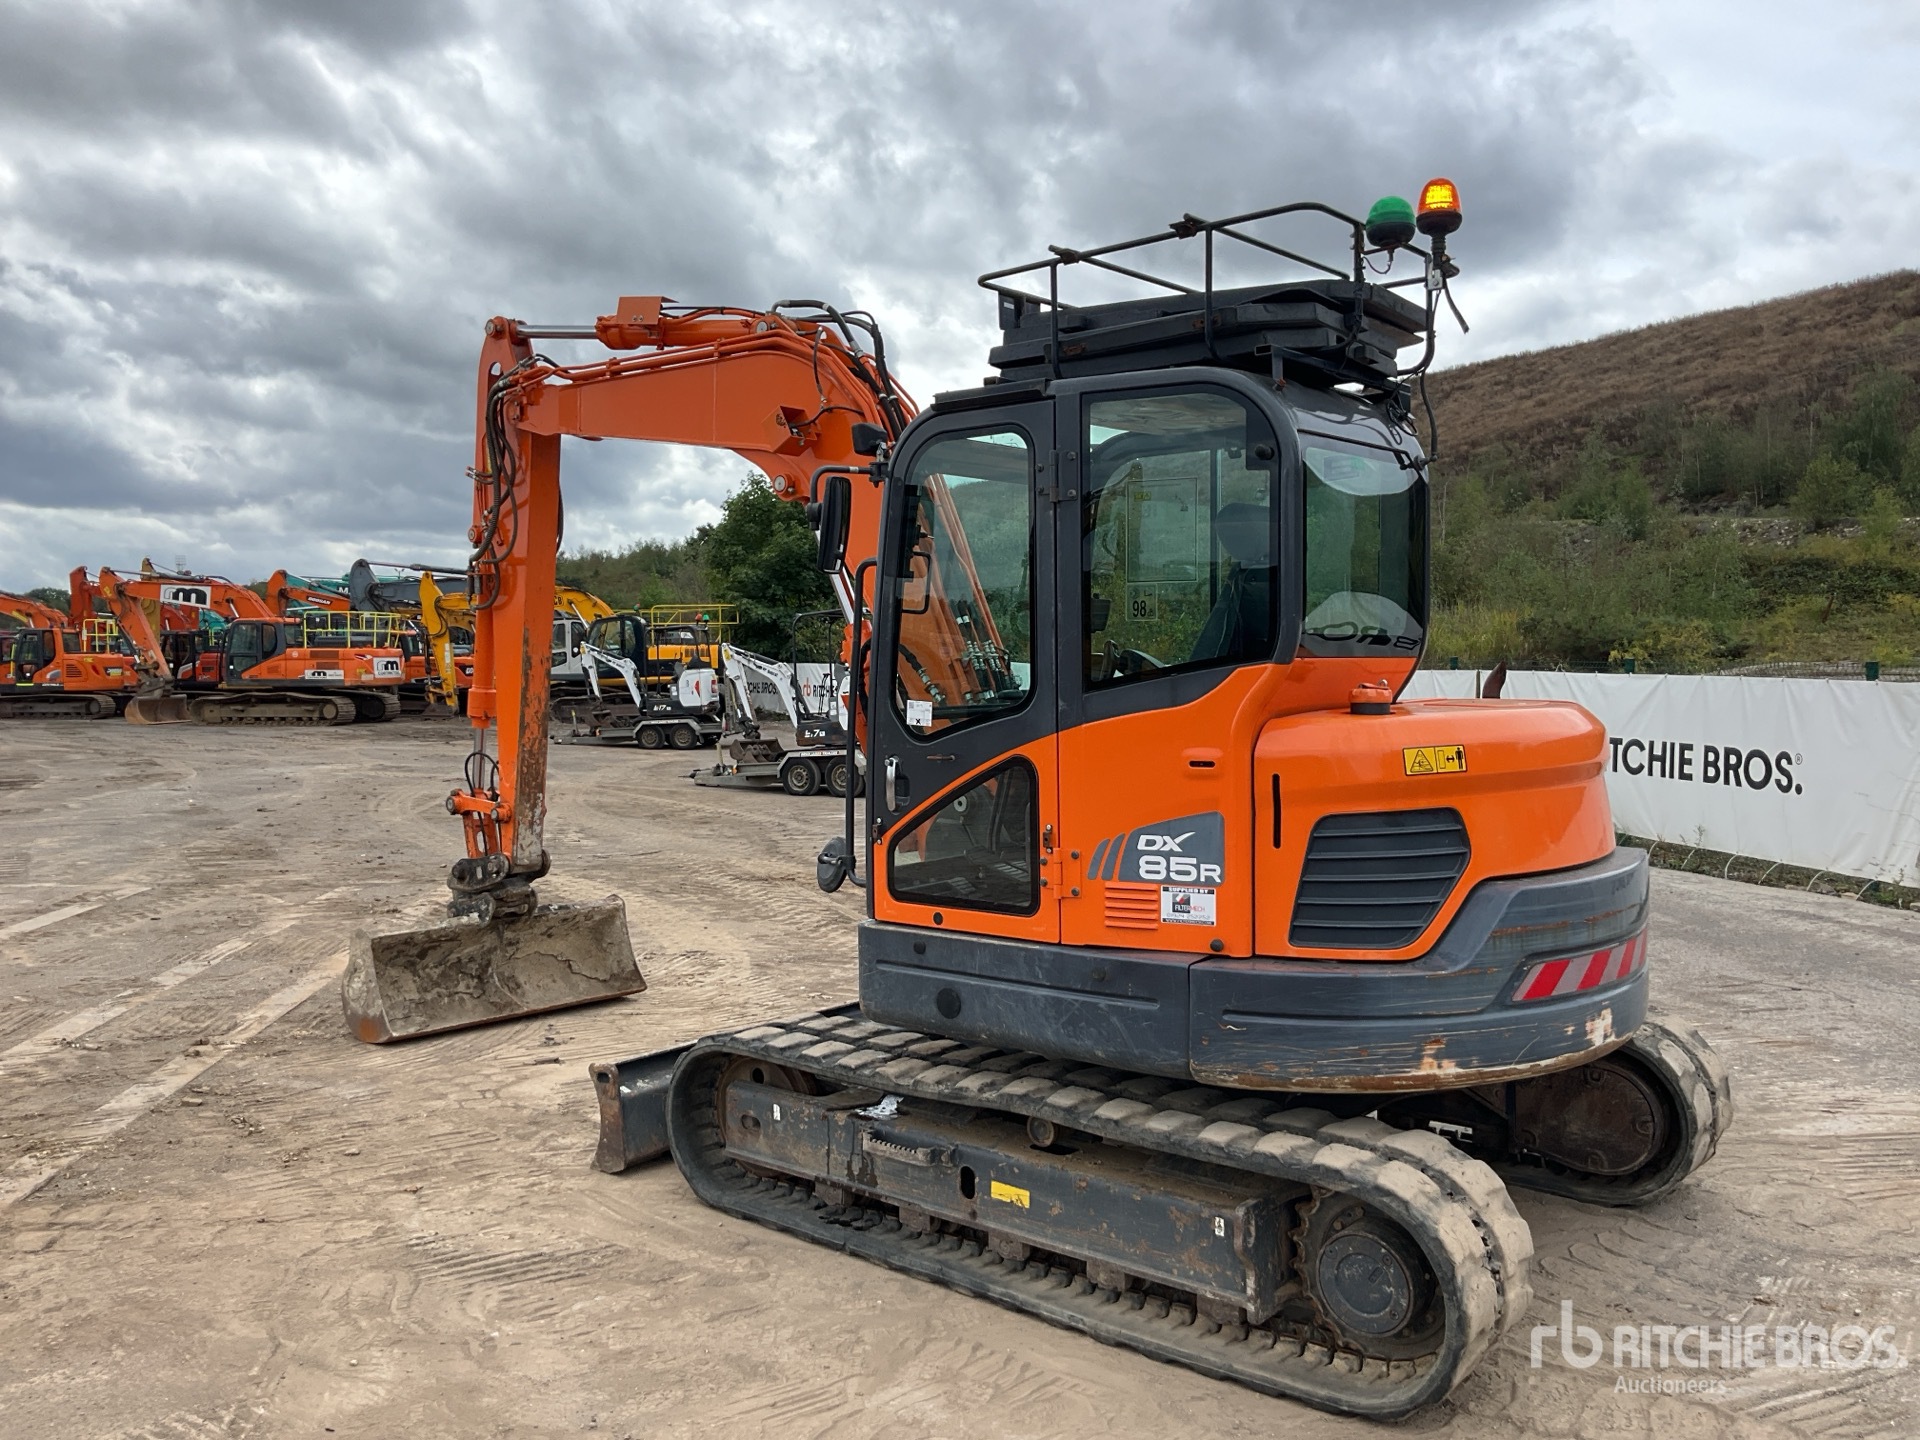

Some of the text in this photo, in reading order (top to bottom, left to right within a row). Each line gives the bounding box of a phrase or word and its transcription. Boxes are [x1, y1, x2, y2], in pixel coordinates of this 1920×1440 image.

[1132, 600, 1147, 617] 98
[1609, 737, 1694, 781] TCHIE
[1137, 832, 1196, 852] DX
[1139, 855, 1221, 882] 85R
